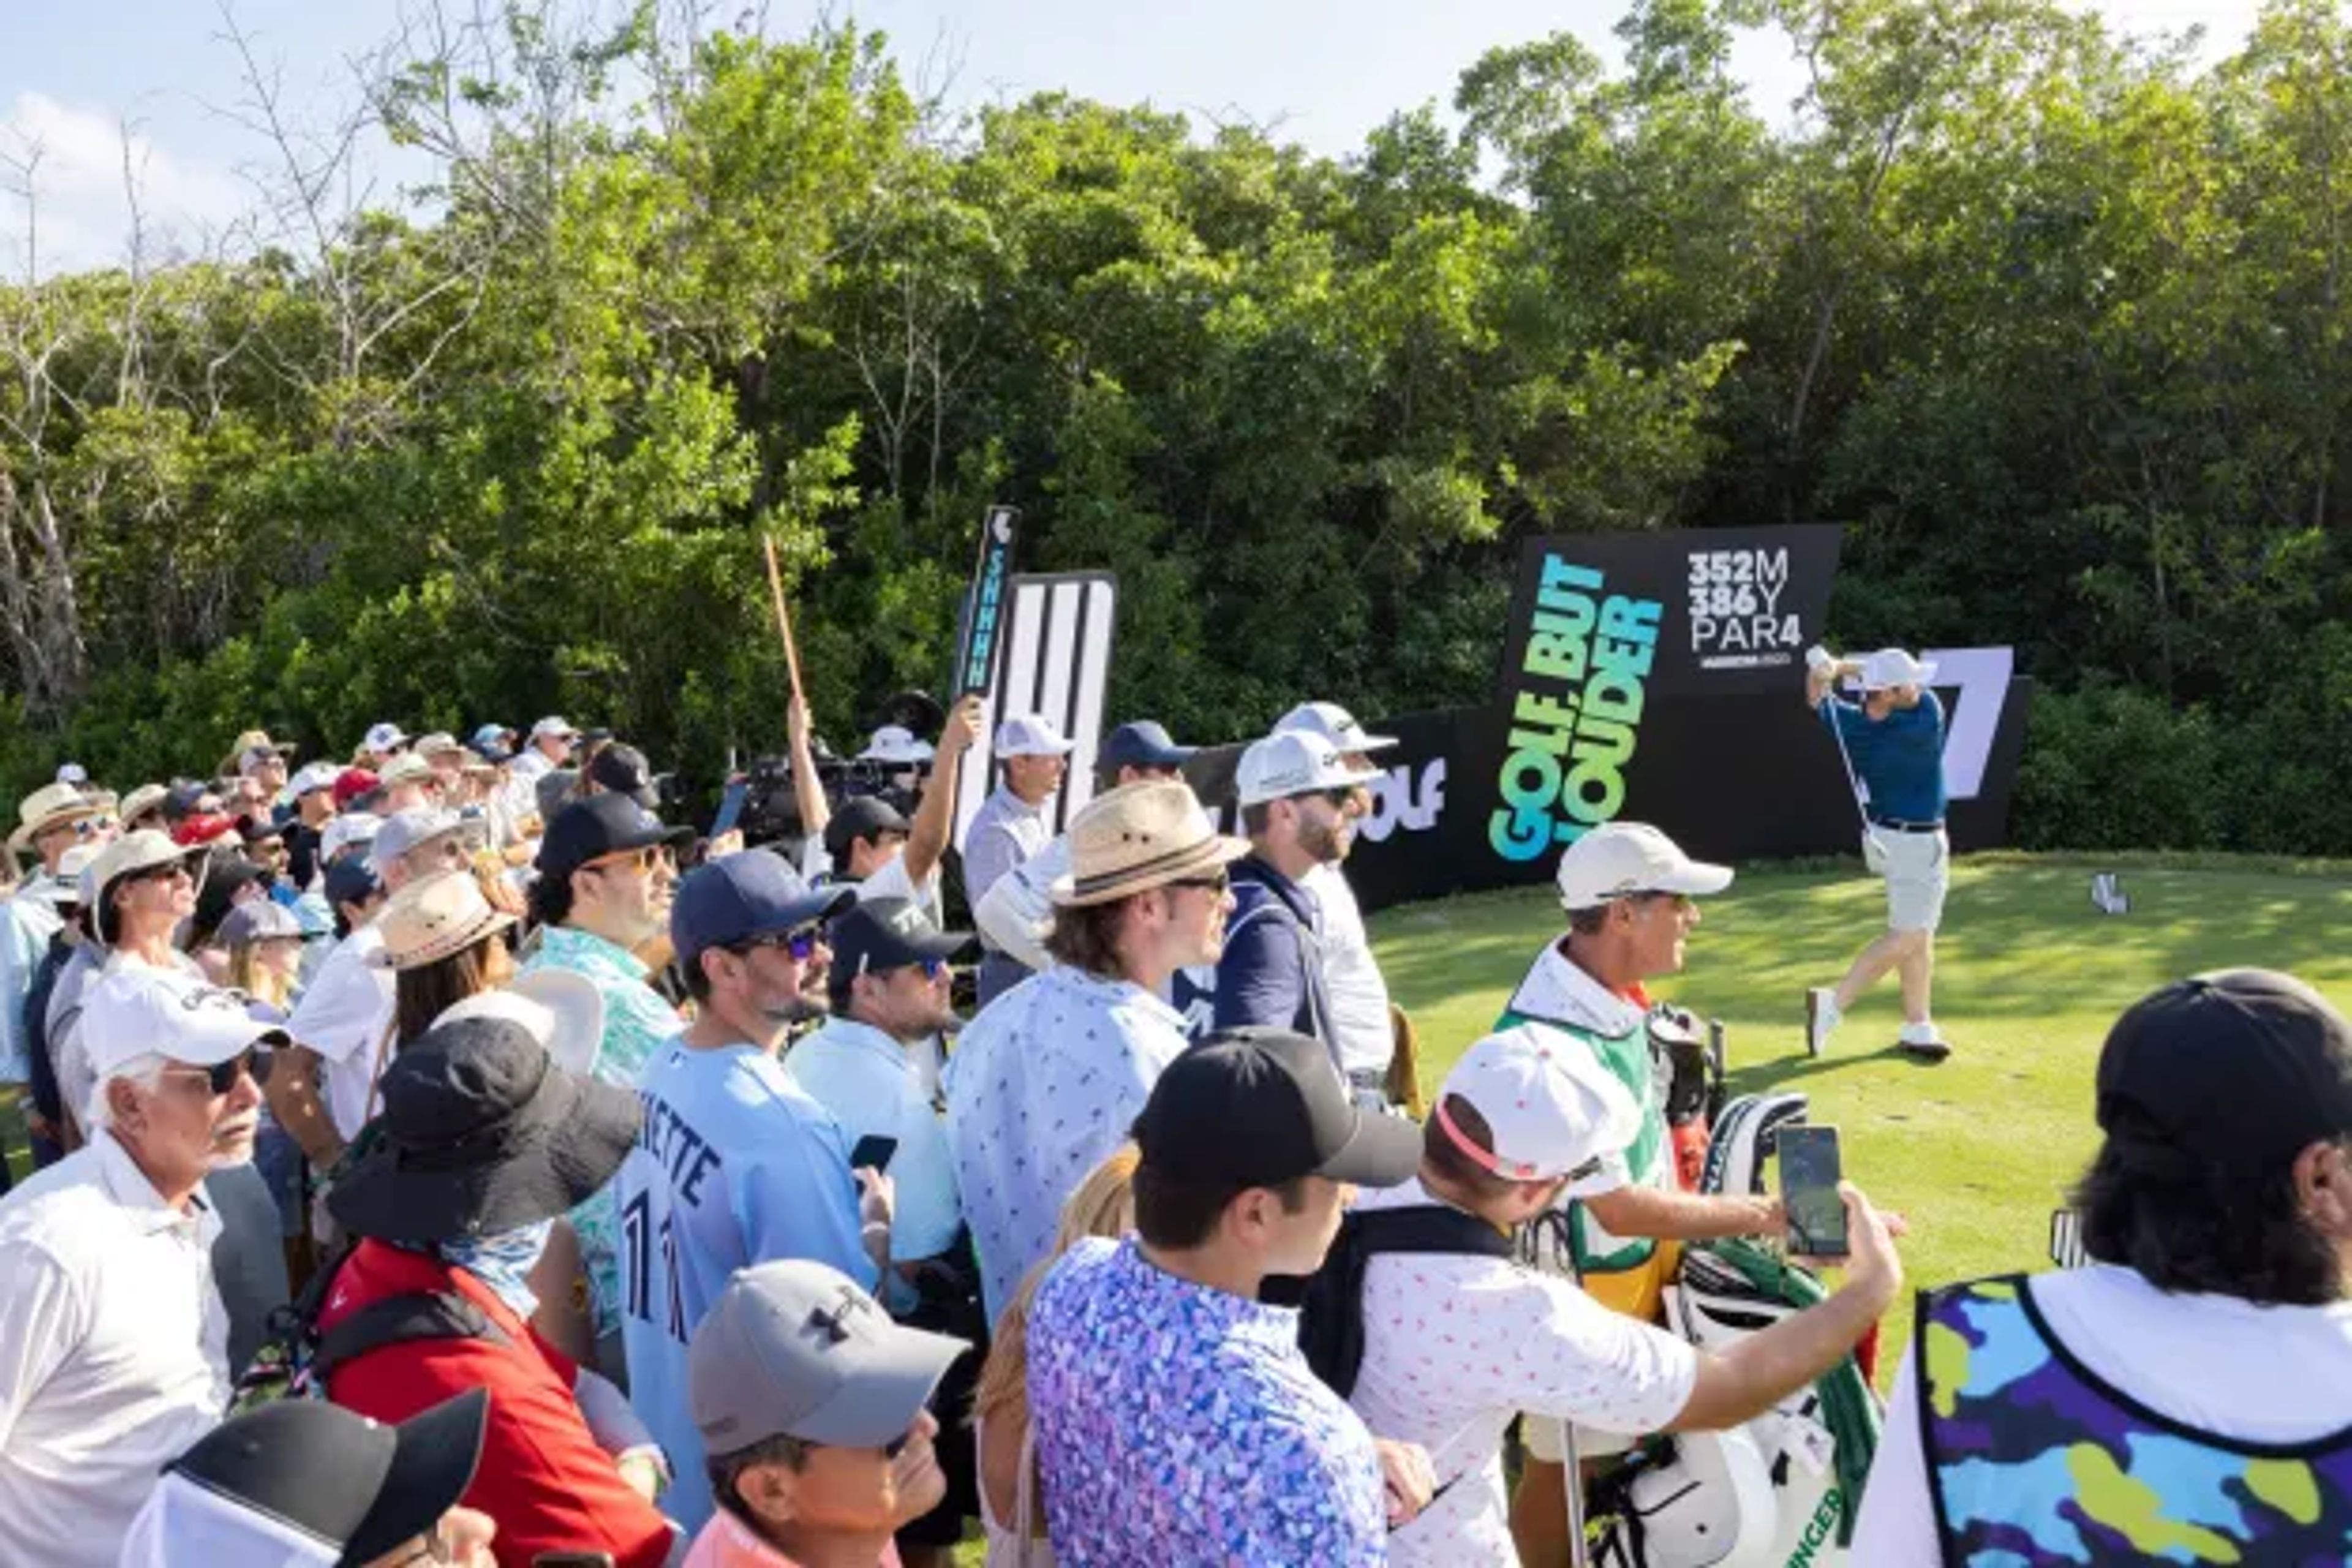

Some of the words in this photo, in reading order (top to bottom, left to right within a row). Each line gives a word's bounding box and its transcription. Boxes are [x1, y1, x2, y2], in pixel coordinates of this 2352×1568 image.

[1523, 554, 1604, 680] BUT
[1688, 548, 1788, 585] 352M
[1688, 581, 1785, 617] 386Y
[1844, 646, 2014, 799] 7
[622, 1187, 690, 1346] 11
